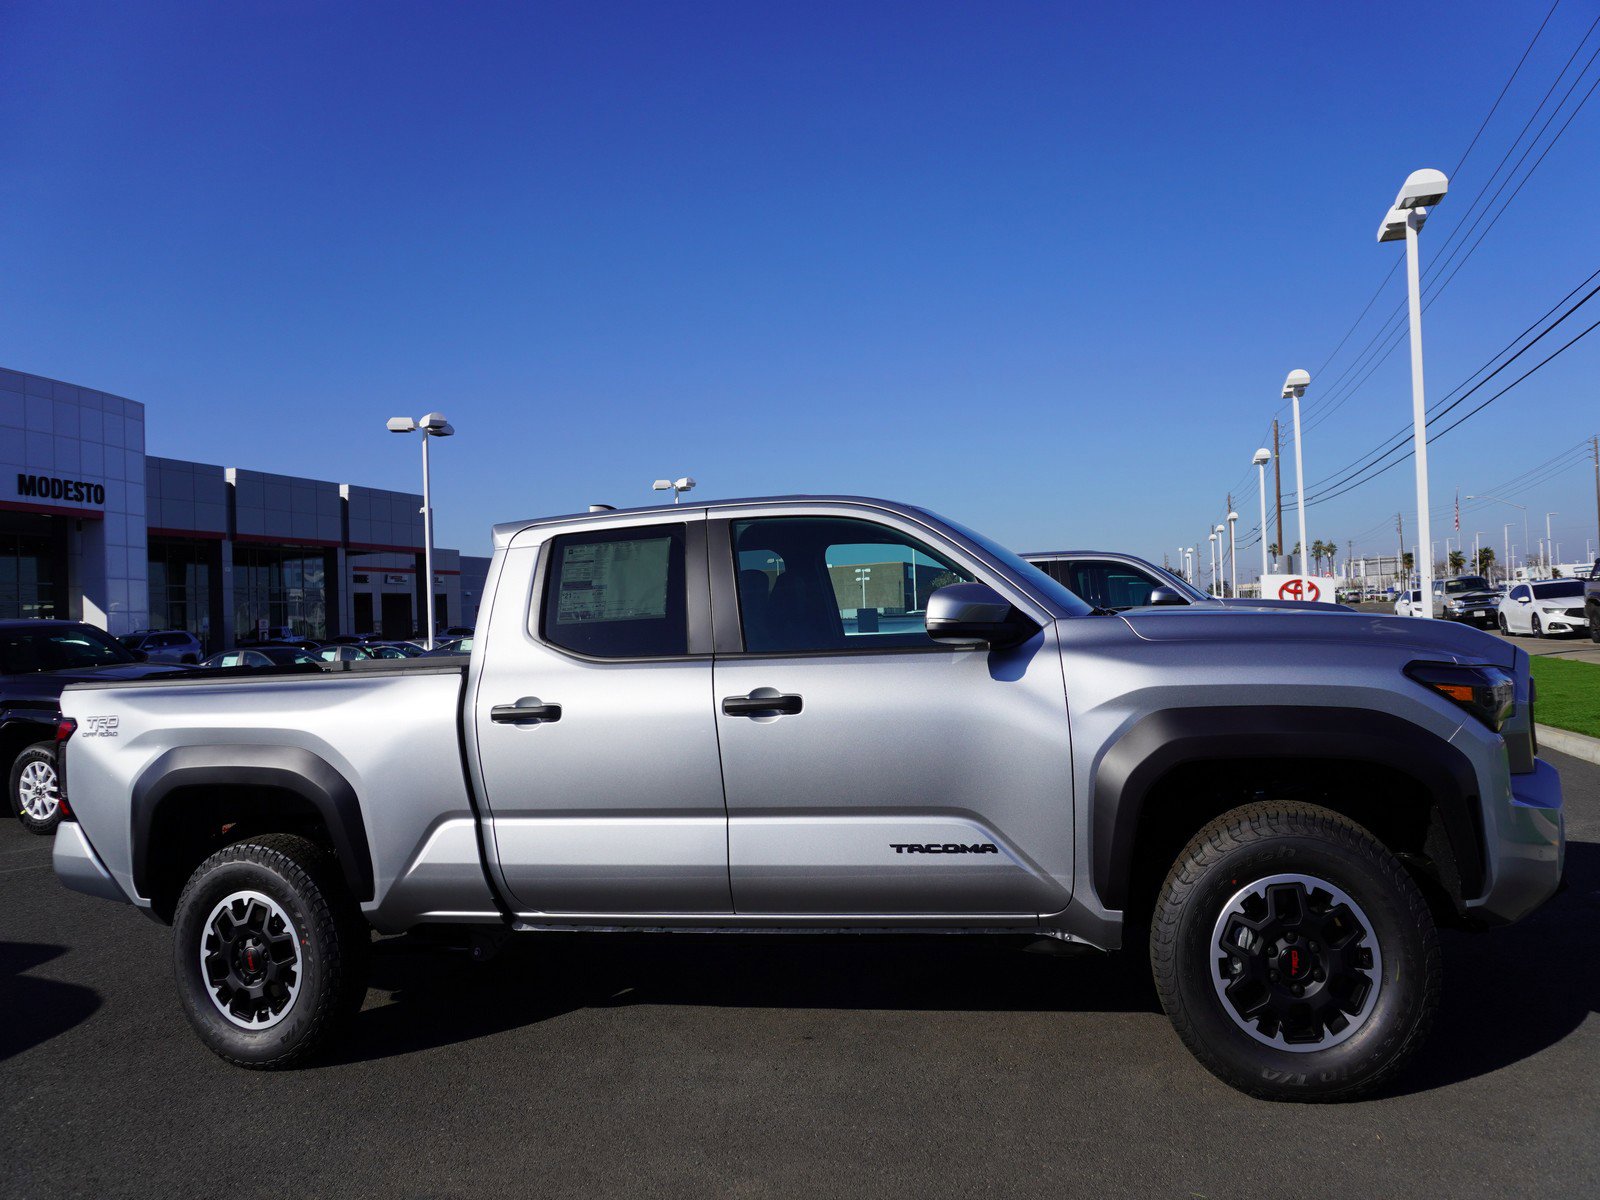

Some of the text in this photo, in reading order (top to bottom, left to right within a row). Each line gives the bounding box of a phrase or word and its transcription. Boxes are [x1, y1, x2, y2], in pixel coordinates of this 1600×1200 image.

[17, 473, 106, 505] MODESTO
[86, 715, 120, 732] TRD
[889, 843, 998, 854] TACOMA
